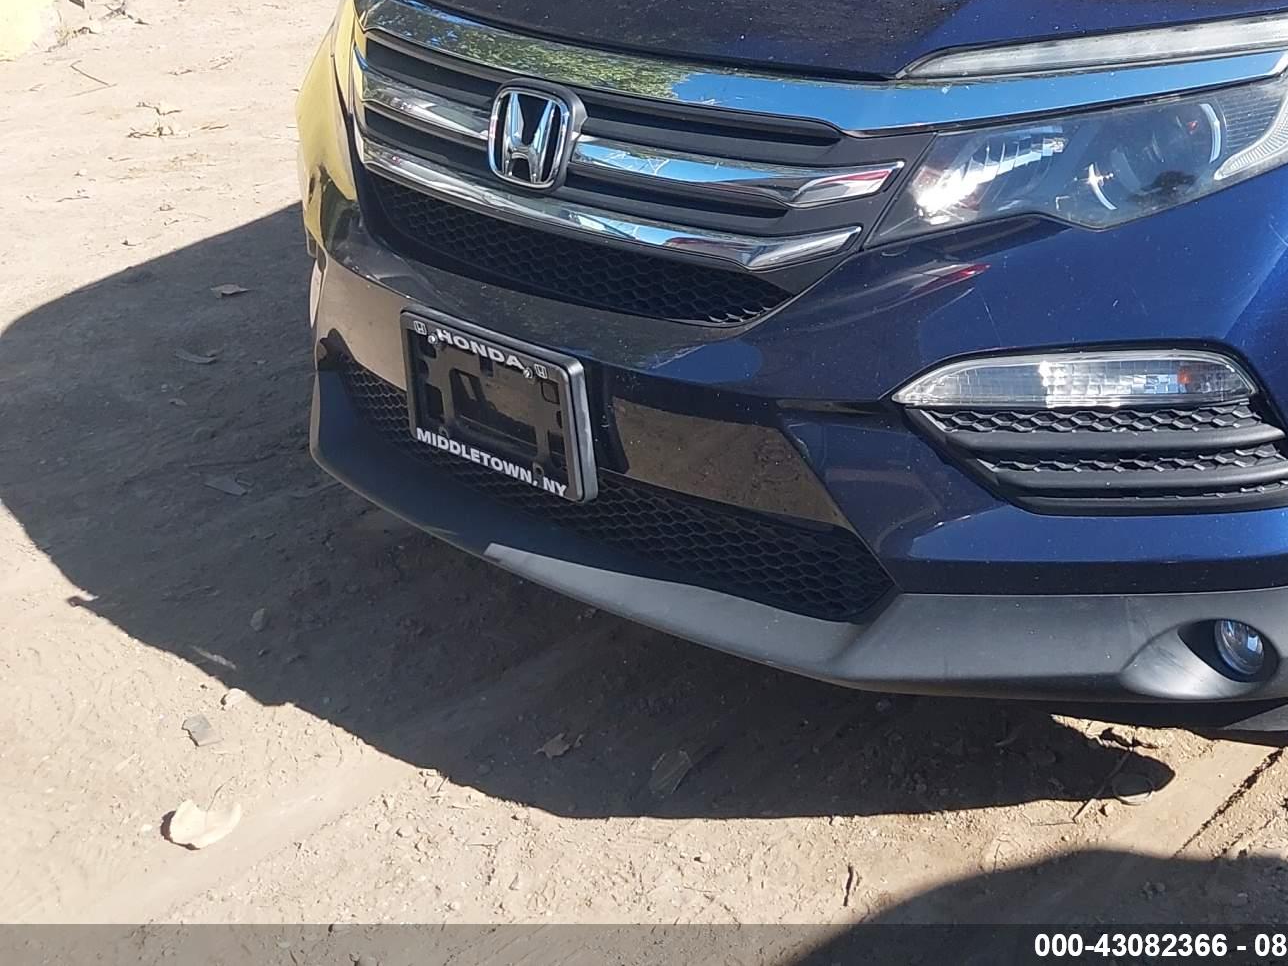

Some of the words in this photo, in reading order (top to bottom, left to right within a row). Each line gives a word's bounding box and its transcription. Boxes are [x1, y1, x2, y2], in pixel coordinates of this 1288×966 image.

[436, 328, 525, 370] HONDA
[416, 427, 538, 487] MIDDLETOWN,
[542, 476, 567, 497] NY
